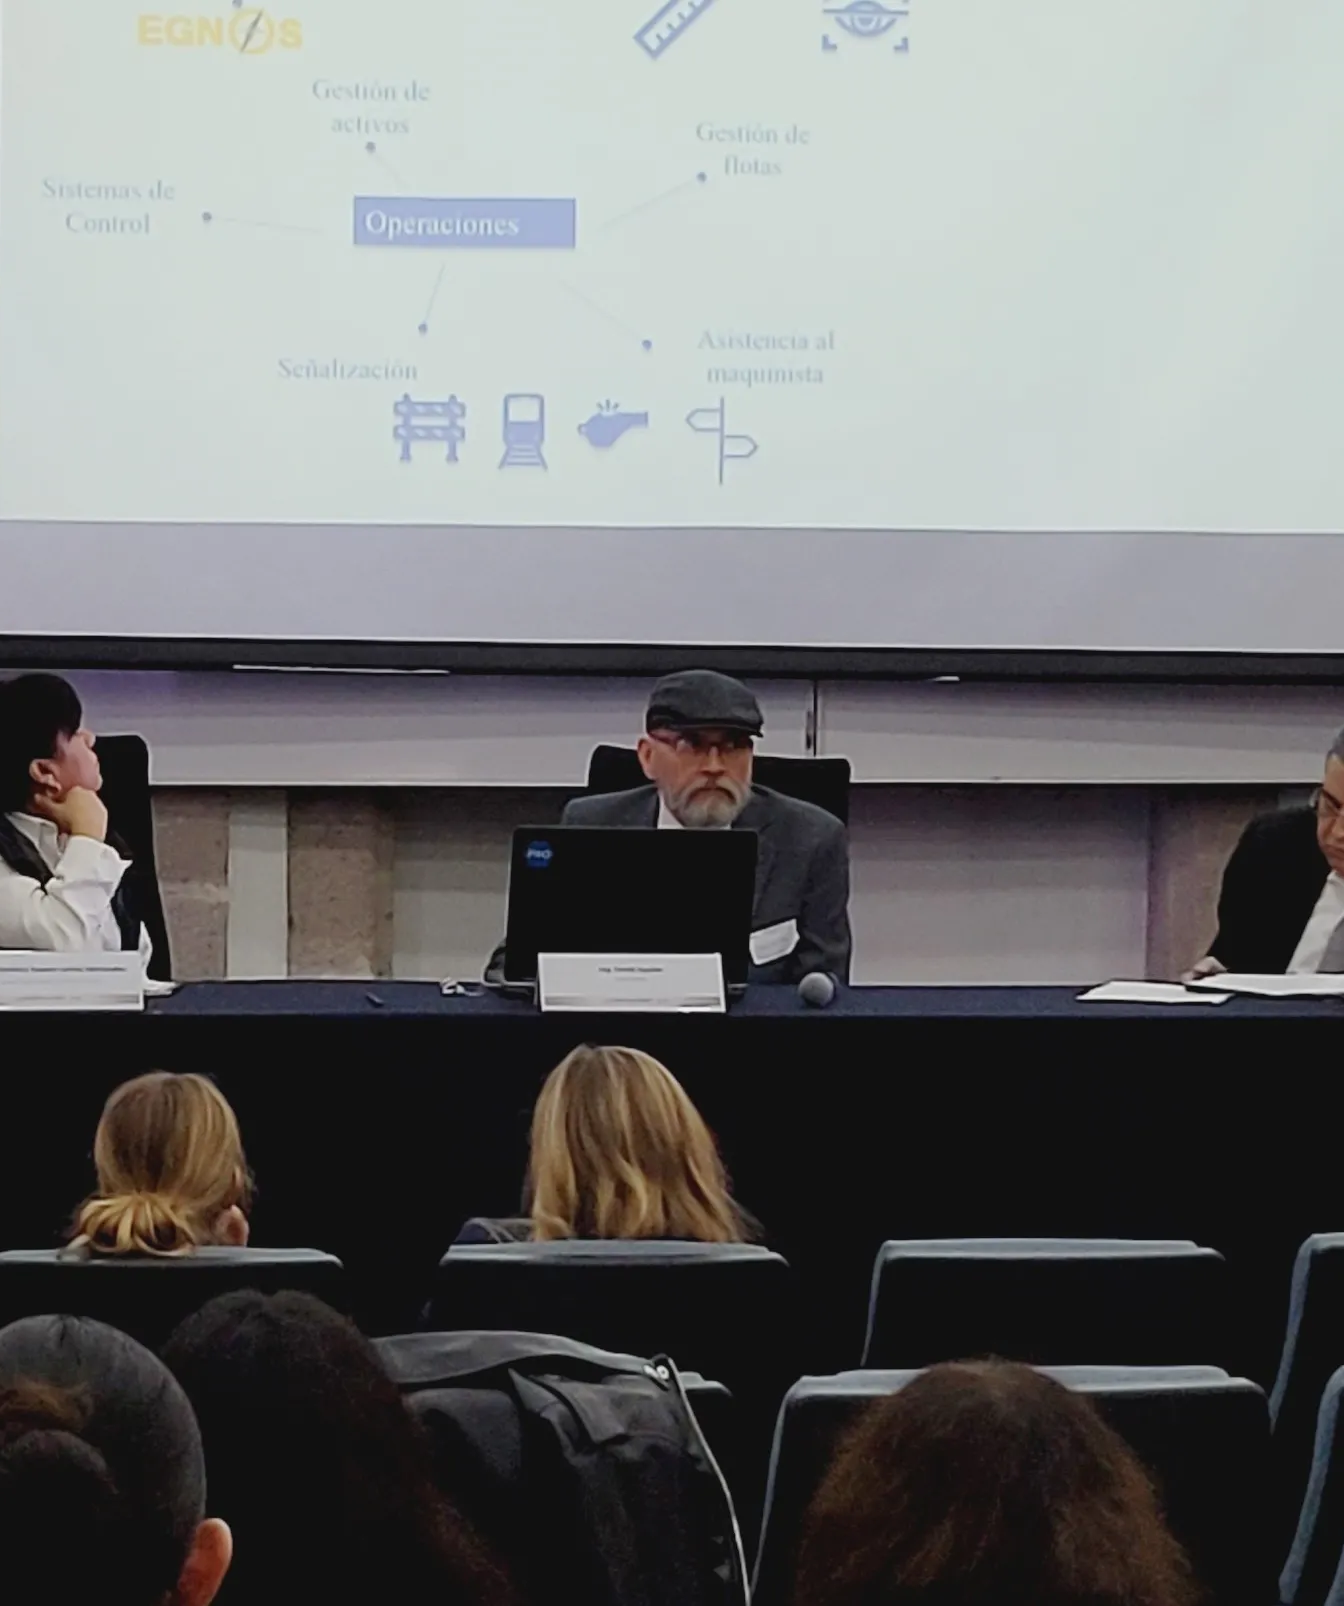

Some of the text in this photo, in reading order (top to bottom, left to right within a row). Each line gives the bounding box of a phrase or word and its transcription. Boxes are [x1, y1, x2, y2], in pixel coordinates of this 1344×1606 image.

[137, 8, 303, 54] EGNOS
[312, 78, 431, 101] Gestión de
[330, 115, 410, 134] activos
[696, 121, 811, 145] Gestión de
[724, 154, 782, 176] flotas
[42, 177, 176, 200] Sistemas de
[65, 212, 150, 234] Control
[365, 209, 520, 240] Operaciones
[697, 329, 836, 351] Asistencia al
[277, 357, 418, 380] Señalización
[706, 365, 824, 388] maquinista
